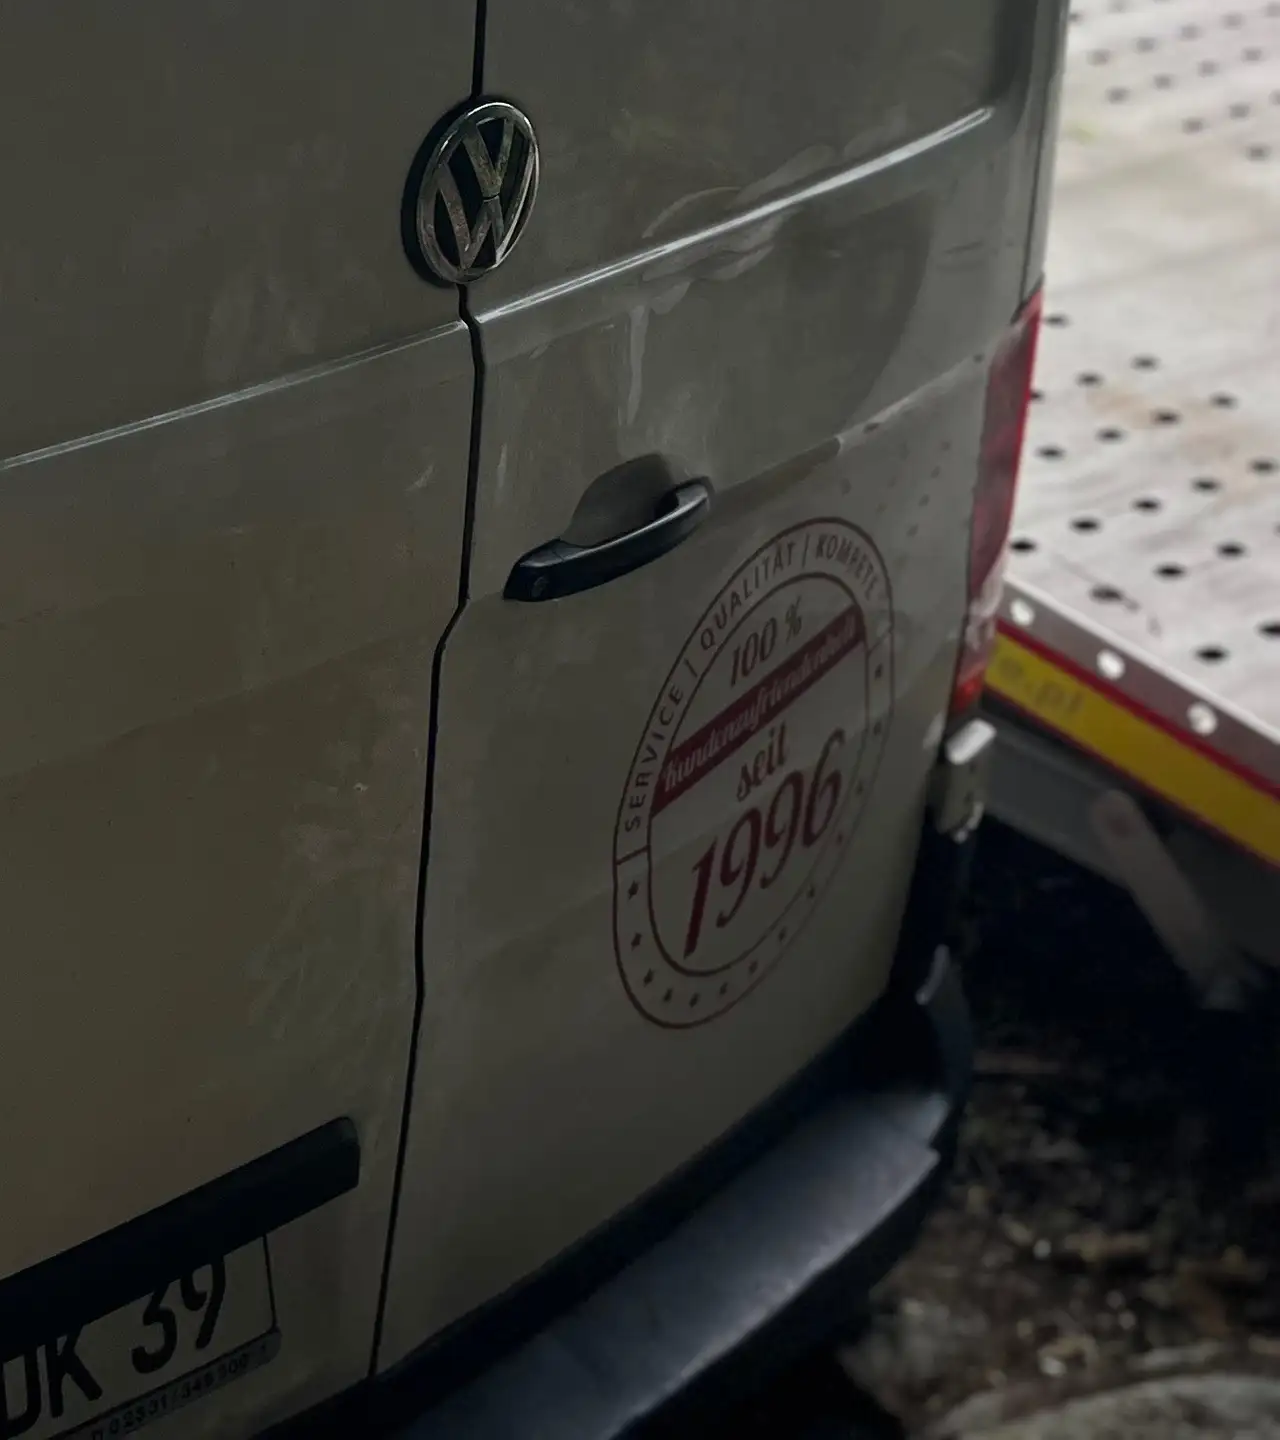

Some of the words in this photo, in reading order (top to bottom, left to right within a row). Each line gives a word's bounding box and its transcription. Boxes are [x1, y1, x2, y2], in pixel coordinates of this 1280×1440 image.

[730, 617, 777, 688] 100
[785, 595, 803, 643] %
[624, 686, 684, 832] SERVICE
[736, 719, 787, 802] seit
[682, 728, 846, 959] 1996
[131, 1258, 226, 1375] 39
